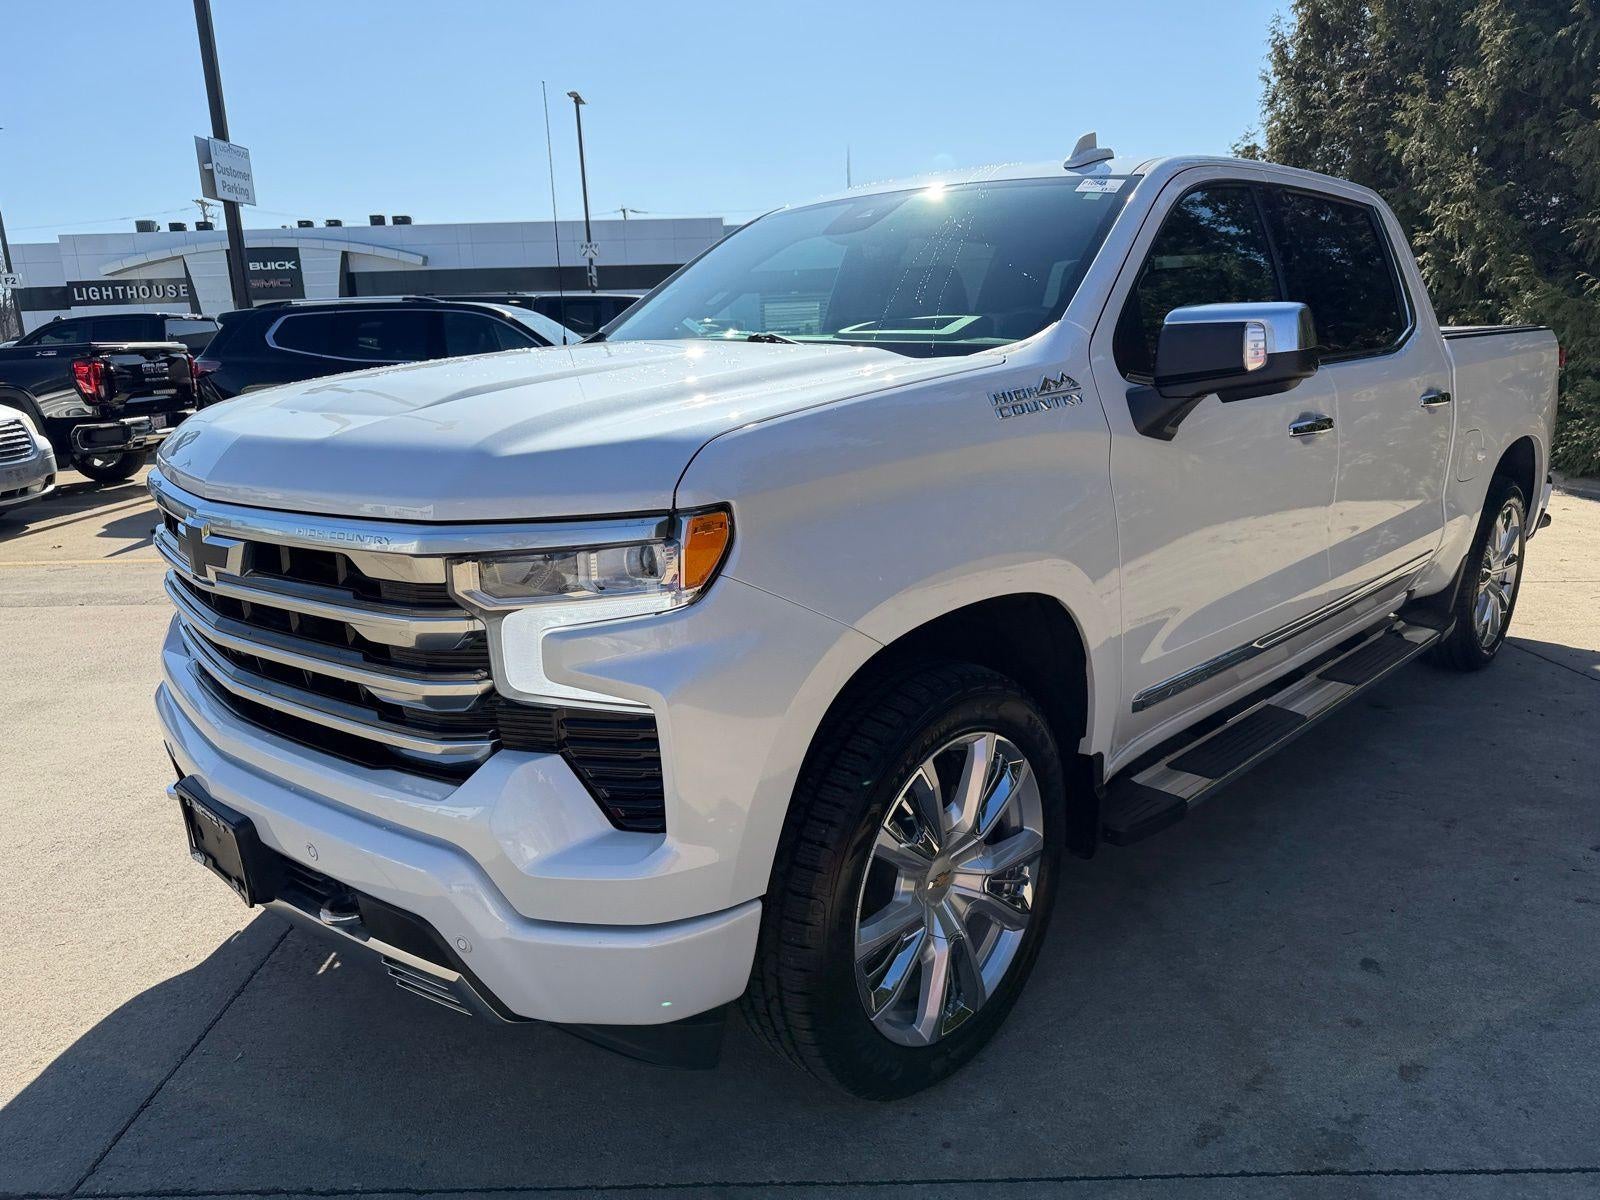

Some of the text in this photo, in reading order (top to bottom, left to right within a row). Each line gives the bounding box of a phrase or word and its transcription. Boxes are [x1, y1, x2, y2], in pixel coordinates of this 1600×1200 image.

[215, 162, 250, 181] Customer
[221, 180, 250, 200] Parking
[248, 260, 298, 271] BUICK
[4, 277, 17, 285] F2
[73, 284, 190, 300] LIGHTHOUSE
[987, 386, 1039, 406] HIGH
[994, 394, 1083, 420] COUNTRY
[328, 532, 393, 545] COUNTRY
